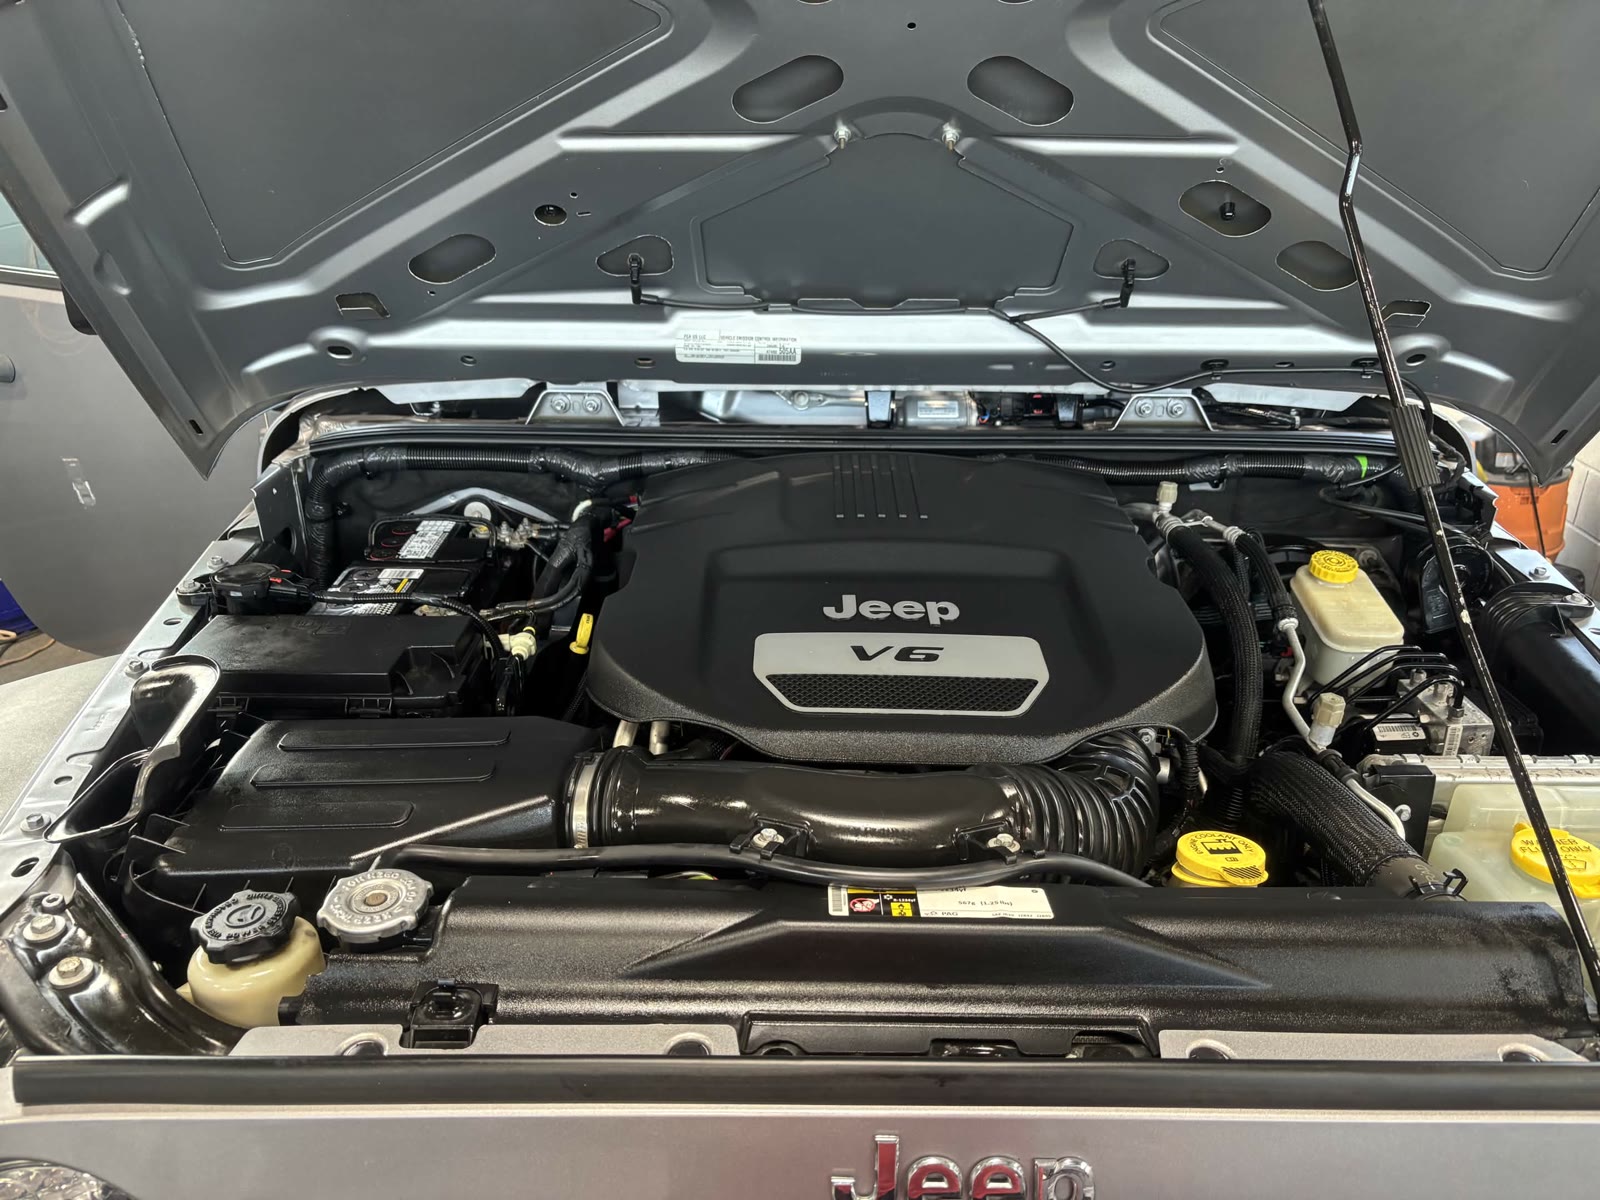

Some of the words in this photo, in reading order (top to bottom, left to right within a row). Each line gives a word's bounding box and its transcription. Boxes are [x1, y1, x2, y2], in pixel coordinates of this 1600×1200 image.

[823, 594, 960, 626] Jeep
[850, 645, 944, 662] V6
[1195, 833, 1238, 841] COOLANT
[1189, 838, 1204, 855] ENGINE
[1238, 840, 1255, 853] ONLY
[1560, 845, 1592, 853] ONLY
[226, 924, 266, 939] POWER
